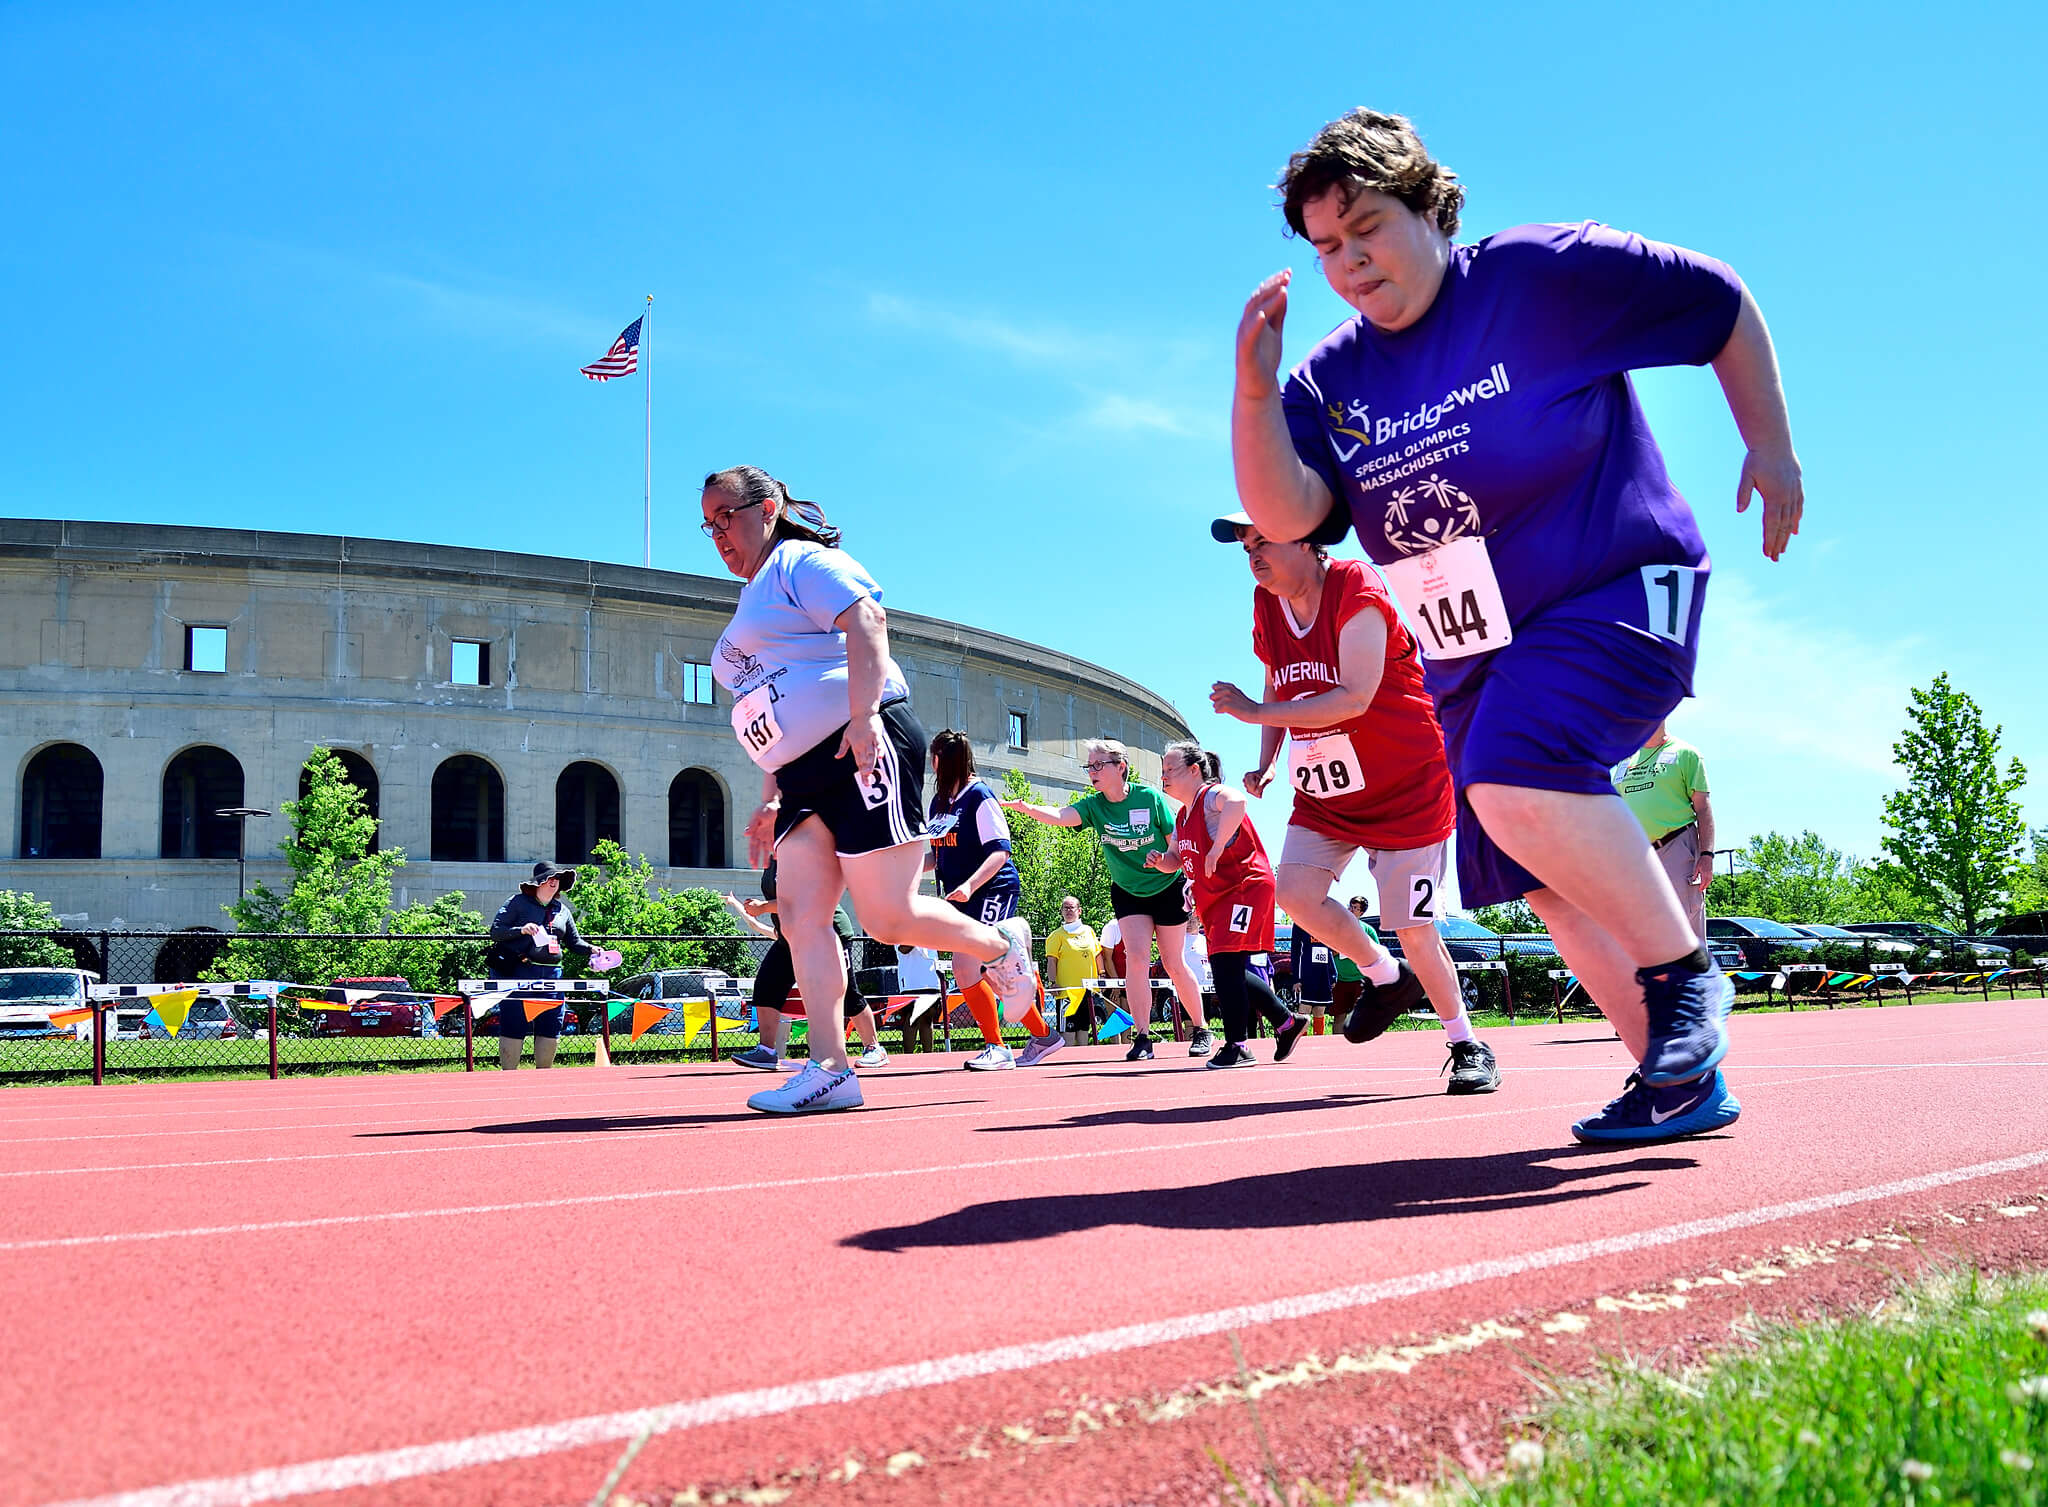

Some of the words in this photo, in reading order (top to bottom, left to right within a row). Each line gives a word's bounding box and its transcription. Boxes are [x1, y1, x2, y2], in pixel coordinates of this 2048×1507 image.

[1375, 362, 1511, 446] Bridgewell
[1355, 451, 1403, 478] SPECIAL
[1404, 422, 1471, 457] OLYMPICS
[1360, 440, 1470, 493] MASSACHUSETTS
[1418, 589, 1488, 649] 144
[1653, 569, 1679, 636] 1
[1273, 660, 1341, 692] AVERHILL
[743, 712, 774, 751] 197
[867, 768, 889, 804] 3
[1296, 759, 1351, 793] 219
[983, 900, 998, 922] 5
[1412, 878, 1434, 918] 2
[1232, 906, 1249, 931] 4
